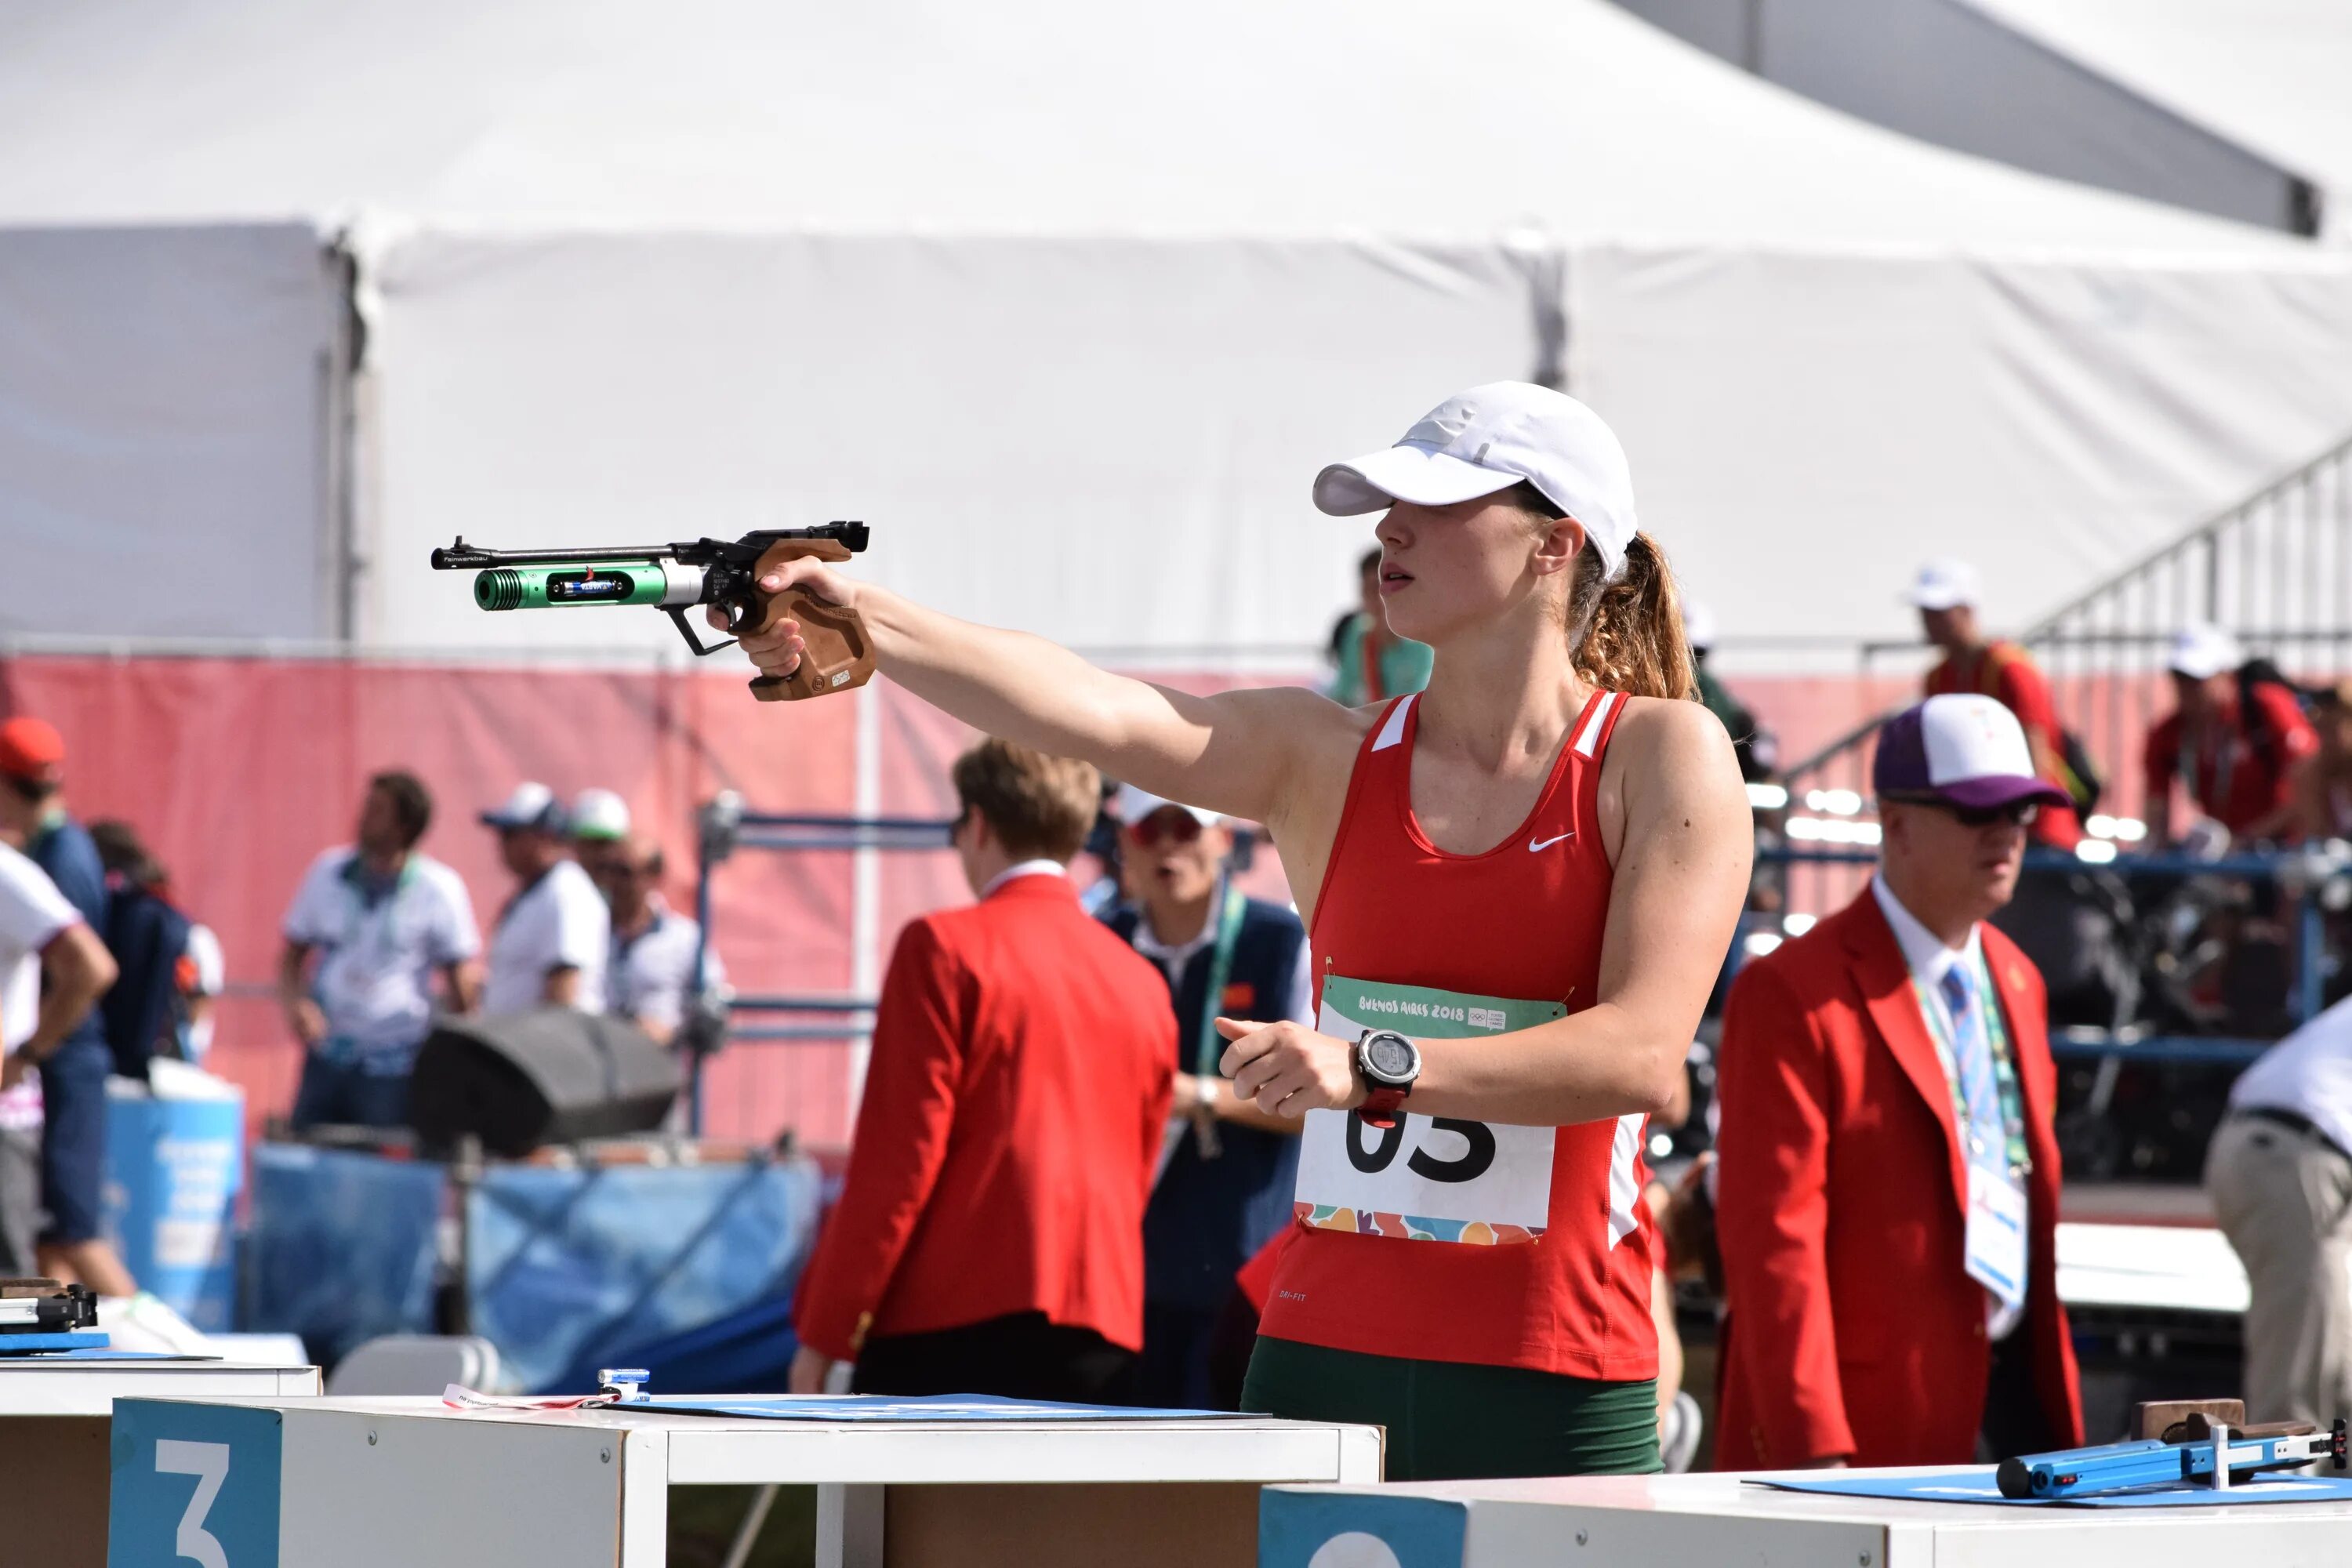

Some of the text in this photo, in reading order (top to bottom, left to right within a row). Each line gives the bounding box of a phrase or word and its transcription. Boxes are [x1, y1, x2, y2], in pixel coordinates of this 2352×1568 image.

[1359, 996, 1465, 1022] BUENOS AIRES 2018
[155, 1439, 230, 1568] 3
